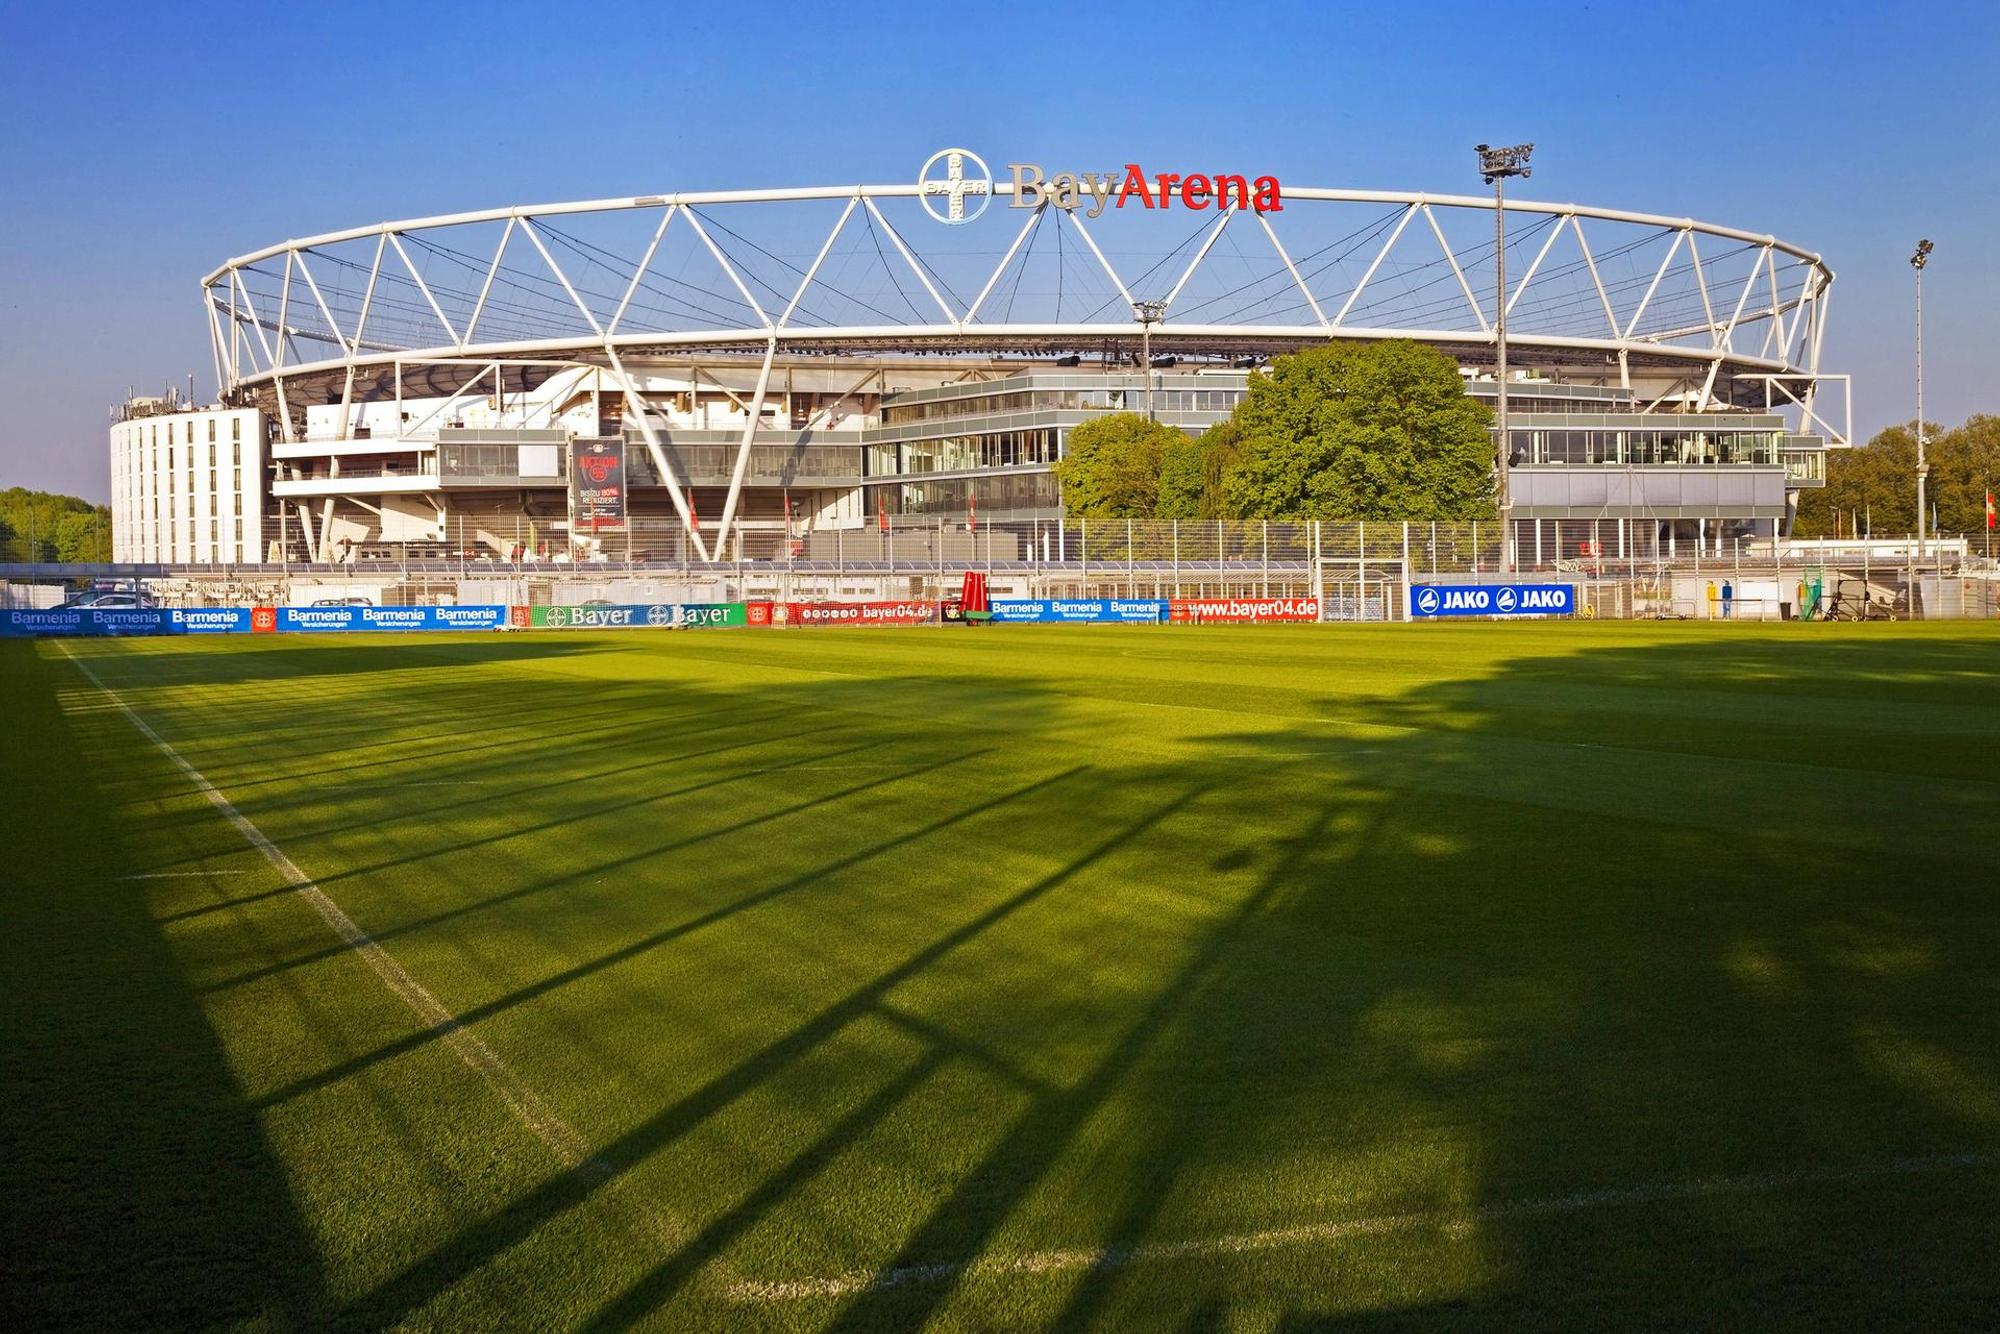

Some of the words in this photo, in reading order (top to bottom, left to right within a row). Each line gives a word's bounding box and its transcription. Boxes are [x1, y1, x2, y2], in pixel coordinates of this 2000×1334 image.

[926, 182, 987, 194] BAYER
[1008, 163, 1284, 219] BayArena
[1443, 591, 1490, 609] JAKO
[1520, 590, 1566, 607] JAKO
[436, 607, 497, 620] Barmenia
[863, 605, 932, 620] bayer04.de
[992, 602, 1043, 613] Barmenia
[1052, 602, 1102, 612] Barmenia
[1188, 600, 1317, 619] www.bayer04.de
[11, 612, 81, 624] Barmenia
[93, 611, 161, 624] Barmenia
[172, 610, 239, 623] Barmenia
[288, 609, 352, 622] Barmenia
[362, 608, 425, 621] Barmenia
[570, 607, 634, 626] Bayer
